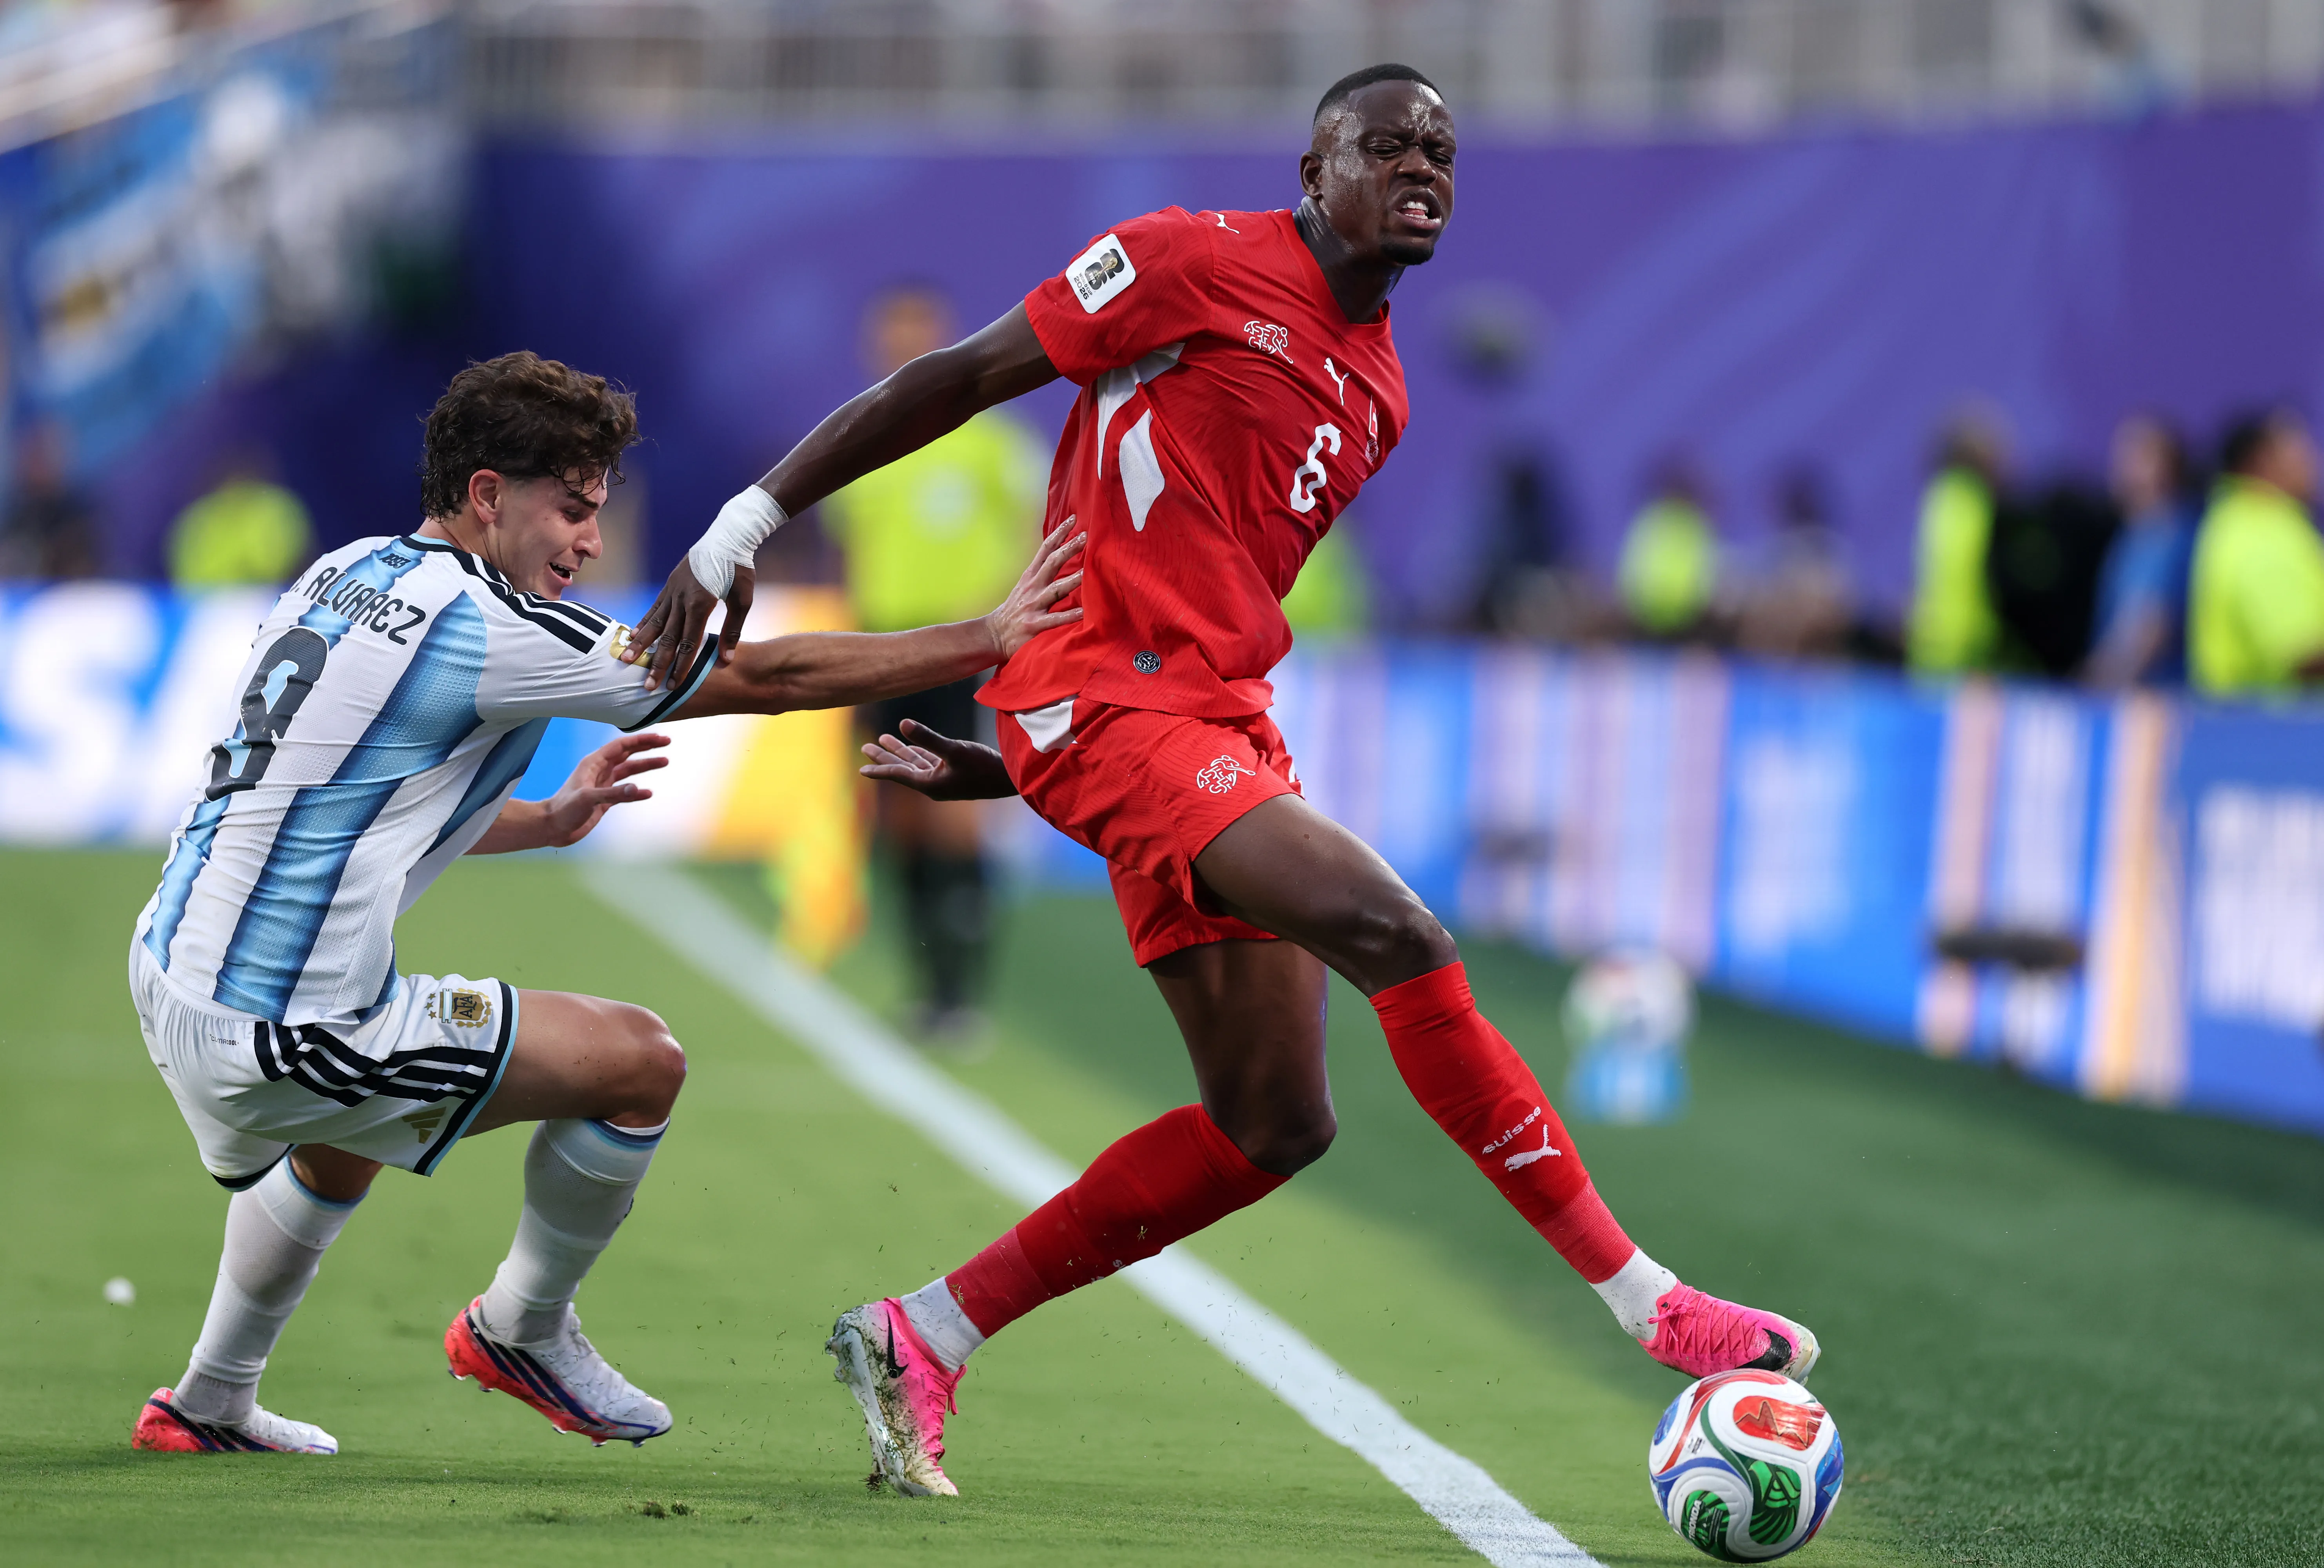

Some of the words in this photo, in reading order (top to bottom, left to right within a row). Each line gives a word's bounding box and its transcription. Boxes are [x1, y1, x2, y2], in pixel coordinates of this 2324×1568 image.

[1074, 276, 1089, 300] 2026
[1079, 272, 1088, 287] WORLD
[1290, 422, 1341, 514] 6
[378, 553, 412, 569] 1893
[302, 566, 426, 645] ALVAREZ
[205, 626, 329, 802] 9
[1483, 1106, 1541, 1155] suisse
